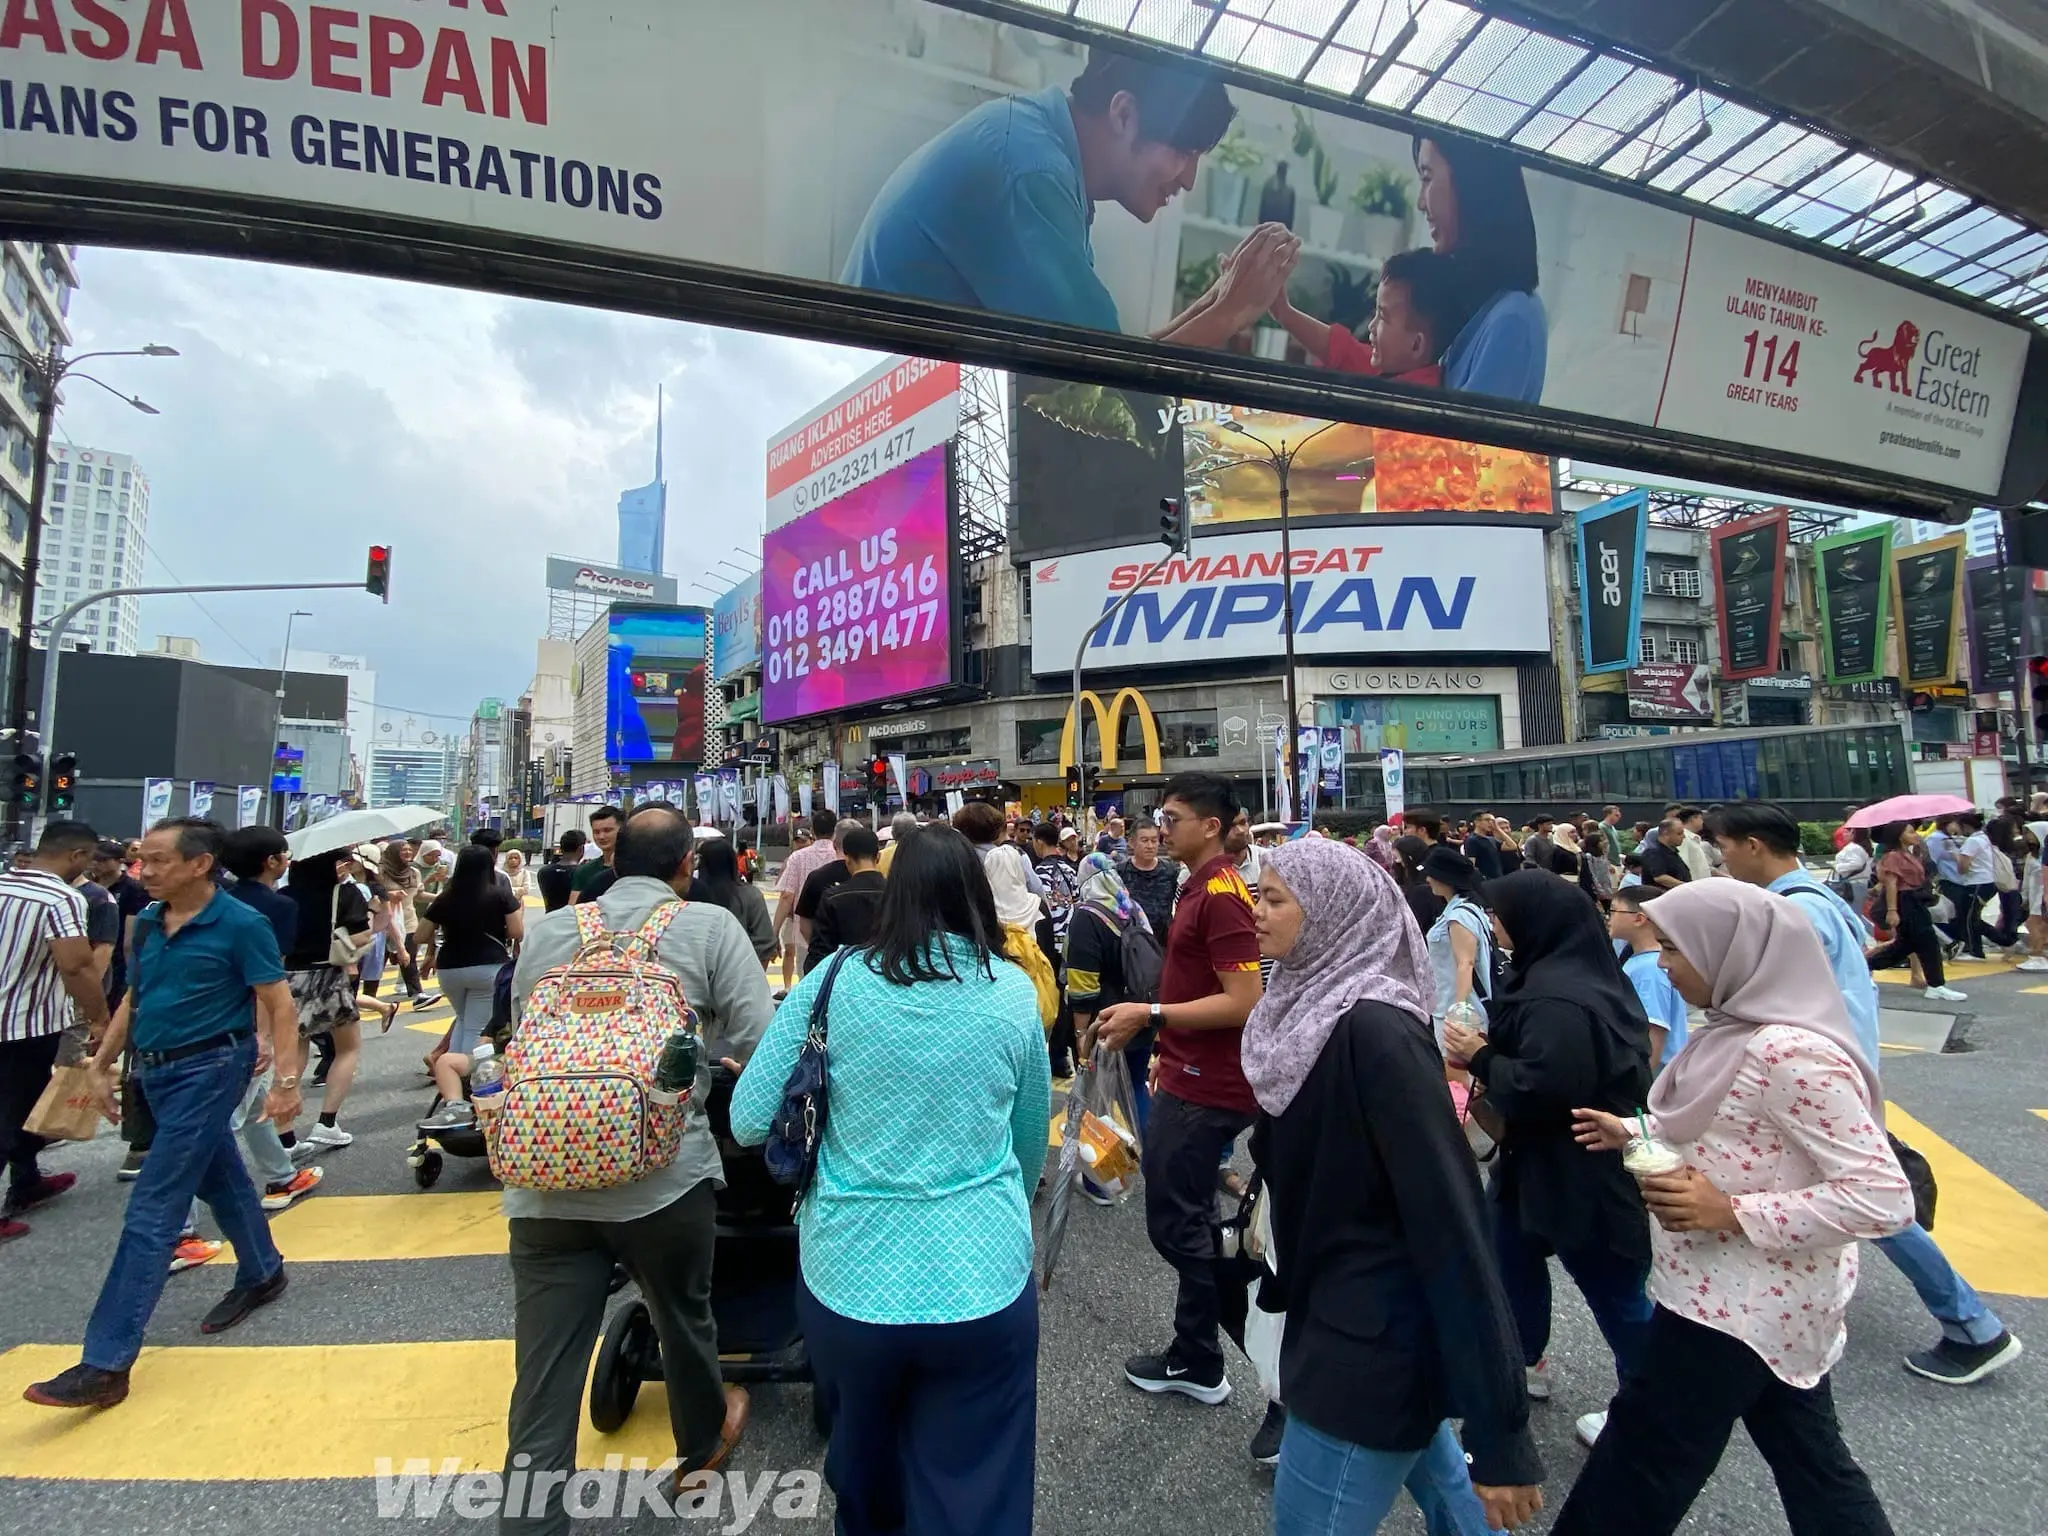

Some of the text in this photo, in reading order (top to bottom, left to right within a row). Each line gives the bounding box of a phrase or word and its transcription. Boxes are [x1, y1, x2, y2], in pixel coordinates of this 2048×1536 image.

[241, 0, 549, 126] DEPAN
[0, 79, 663, 221] IANS FOR GENERATIONS
[1726, 296, 1828, 337] ULANG TAHUN KE-
[1745, 278, 1818, 313] MENYAMBUT
[1744, 329, 1800, 388] 114
[1923, 330, 1982, 378] Great
[1726, 383, 1799, 412] GREAT YEARS
[1916, 367, 1990, 418] Eastern
[769, 433, 805, 473] RUANG
[807, 407, 844, 447] IKLAN
[847, 376, 892, 423] UNTUK
[810, 405, 893, 472] ADVERTISE HERE
[1157, 401, 1234, 434] yang
[811, 426, 916, 502] 012-2321 477
[576, 568, 653, 589] Pioneer
[793, 527, 898, 600] CALL US
[1108, 546, 1383, 591] SEMANGAT
[1599, 540, 1621, 607] acer
[768, 554, 938, 648] 018 2887616
[1088, 576, 1477, 648] IMPIAN
[768, 643, 810, 684] 012
[817, 599, 939, 670] 3491477
[1329, 672, 1484, 690] GIORDANO
[1851, 682, 1893, 694] PULSE
[868, 719, 926, 738] McDonald's
[1415, 709, 1488, 720] LIVING YOUR
[1416, 720, 1488, 731] COLOURS
[575, 995, 622, 1008] UZAYR
